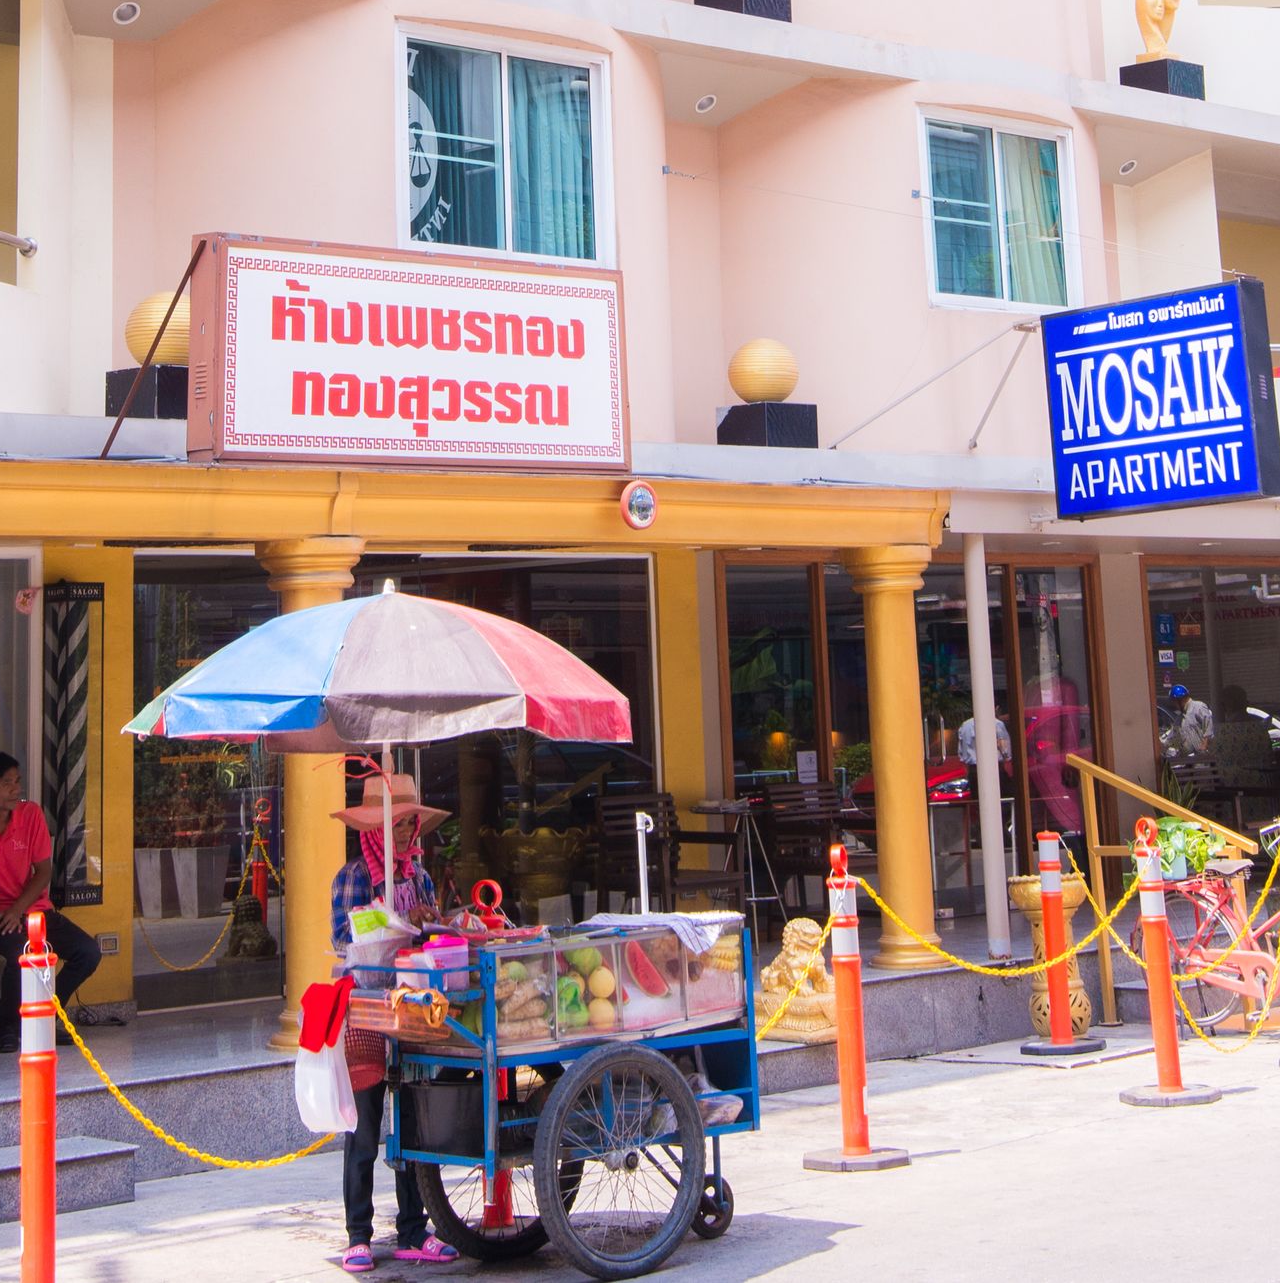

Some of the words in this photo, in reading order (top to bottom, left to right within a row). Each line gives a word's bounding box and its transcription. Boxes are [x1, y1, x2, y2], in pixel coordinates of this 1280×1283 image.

[271, 279, 586, 360] ห้างเพชรทอง
[291, 370, 570, 438] ทองสุวรรณ
[1056, 334, 1242, 442] MOSAIK
[1069, 441, 1243, 501] APARTMENT
[70, 892, 98, 900] SALON
